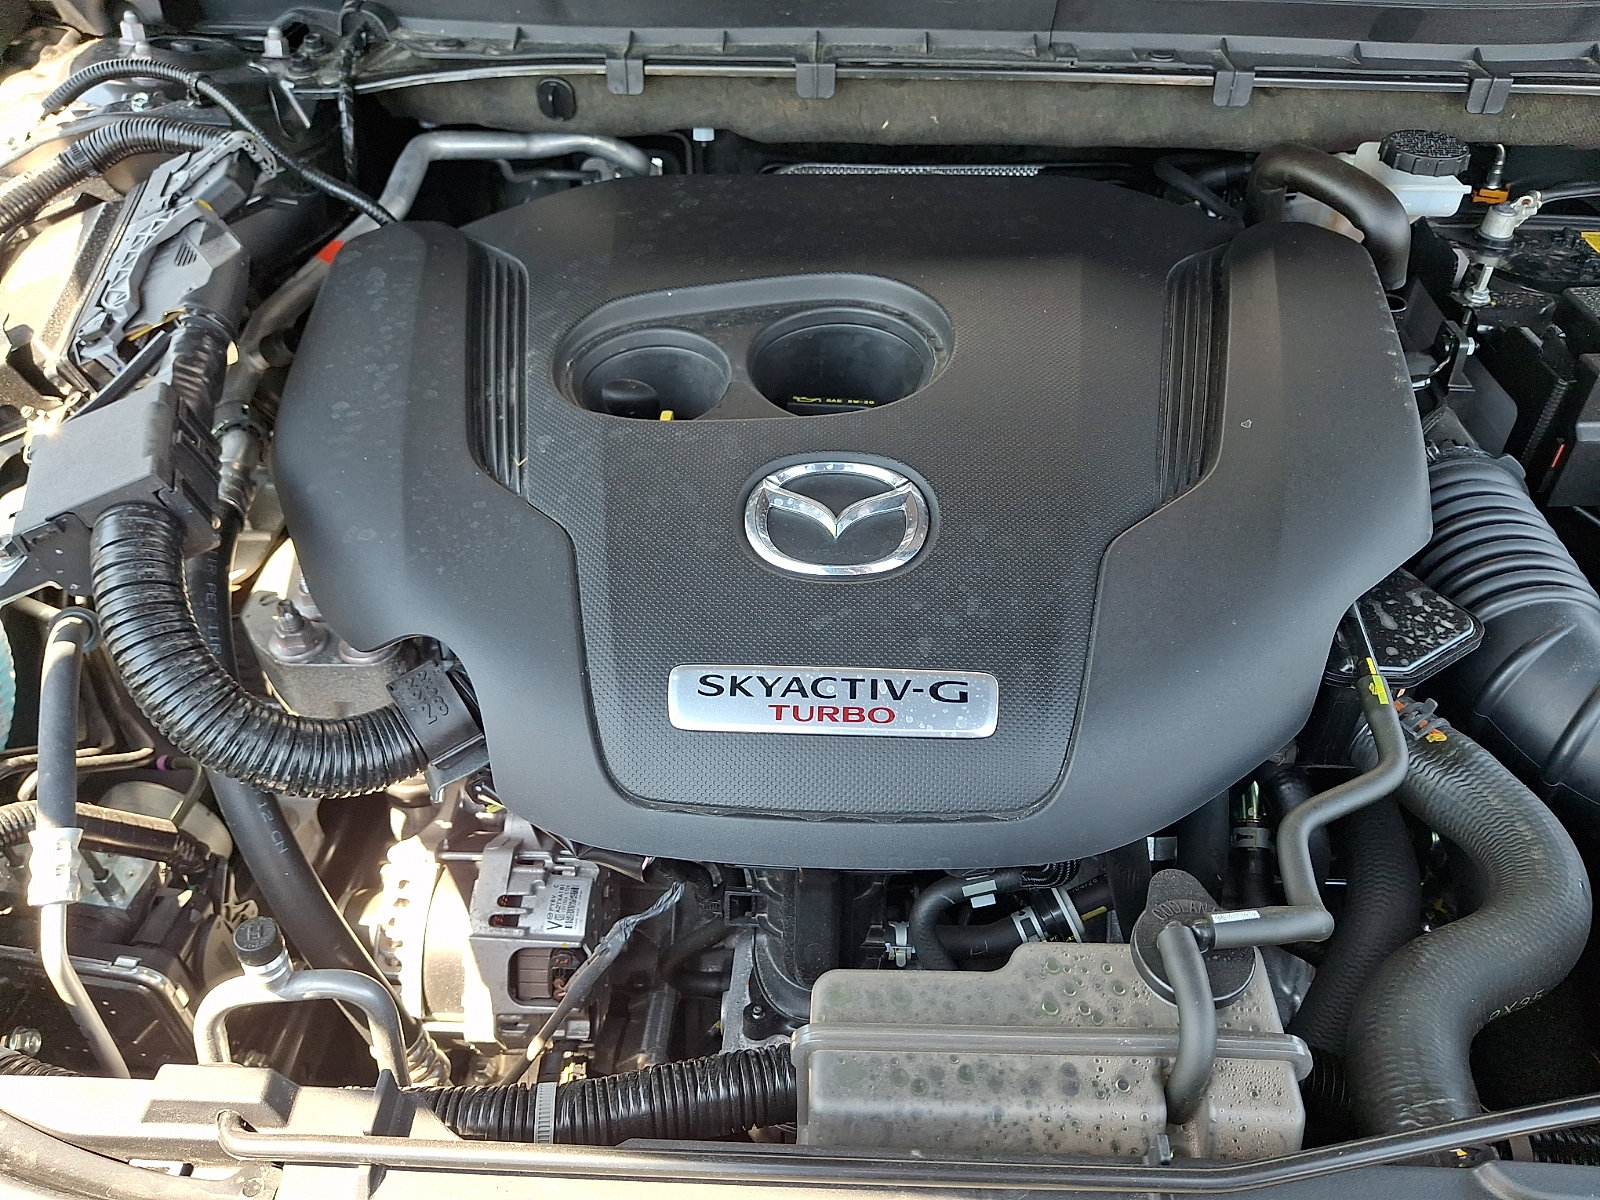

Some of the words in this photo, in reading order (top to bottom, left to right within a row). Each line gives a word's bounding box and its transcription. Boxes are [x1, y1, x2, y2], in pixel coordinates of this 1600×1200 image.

[697, 674, 969, 703] SKYACTIV-G
[421, 695, 449, 725] 28
[768, 705, 896, 724] TURBO
